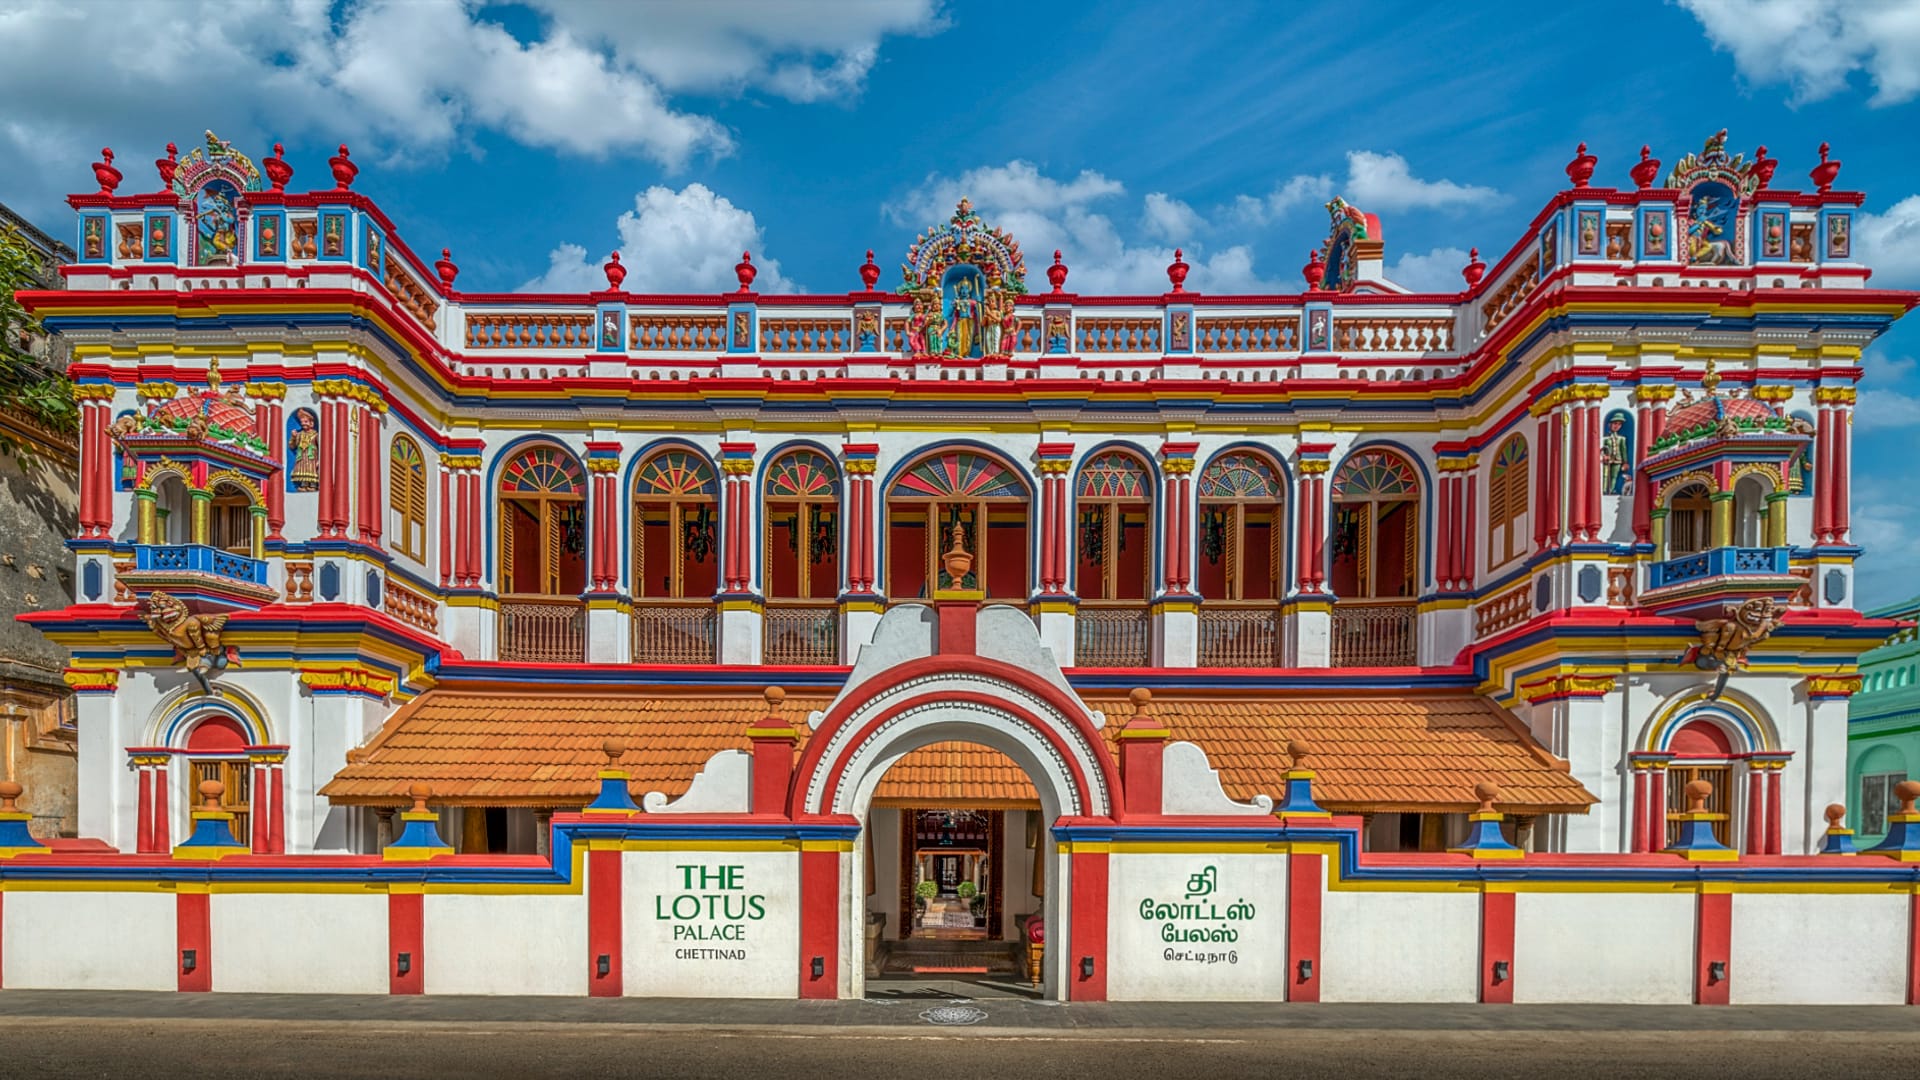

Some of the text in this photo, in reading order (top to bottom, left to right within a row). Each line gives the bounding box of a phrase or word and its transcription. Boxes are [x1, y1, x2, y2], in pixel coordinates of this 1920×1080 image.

[676, 865, 744, 890] THE
[1184, 865, 1217, 900] தி
[656, 895, 766, 920] LOTUS
[1139, 898, 1256, 920] லோட்டஸ்
[674, 924, 745, 941] PALACE
[1161, 923, 1238, 943] பேலஸ்
[675, 948, 746, 960] CHETTINAD
[1163, 947, 1238, 964] செட்டிநாடு
